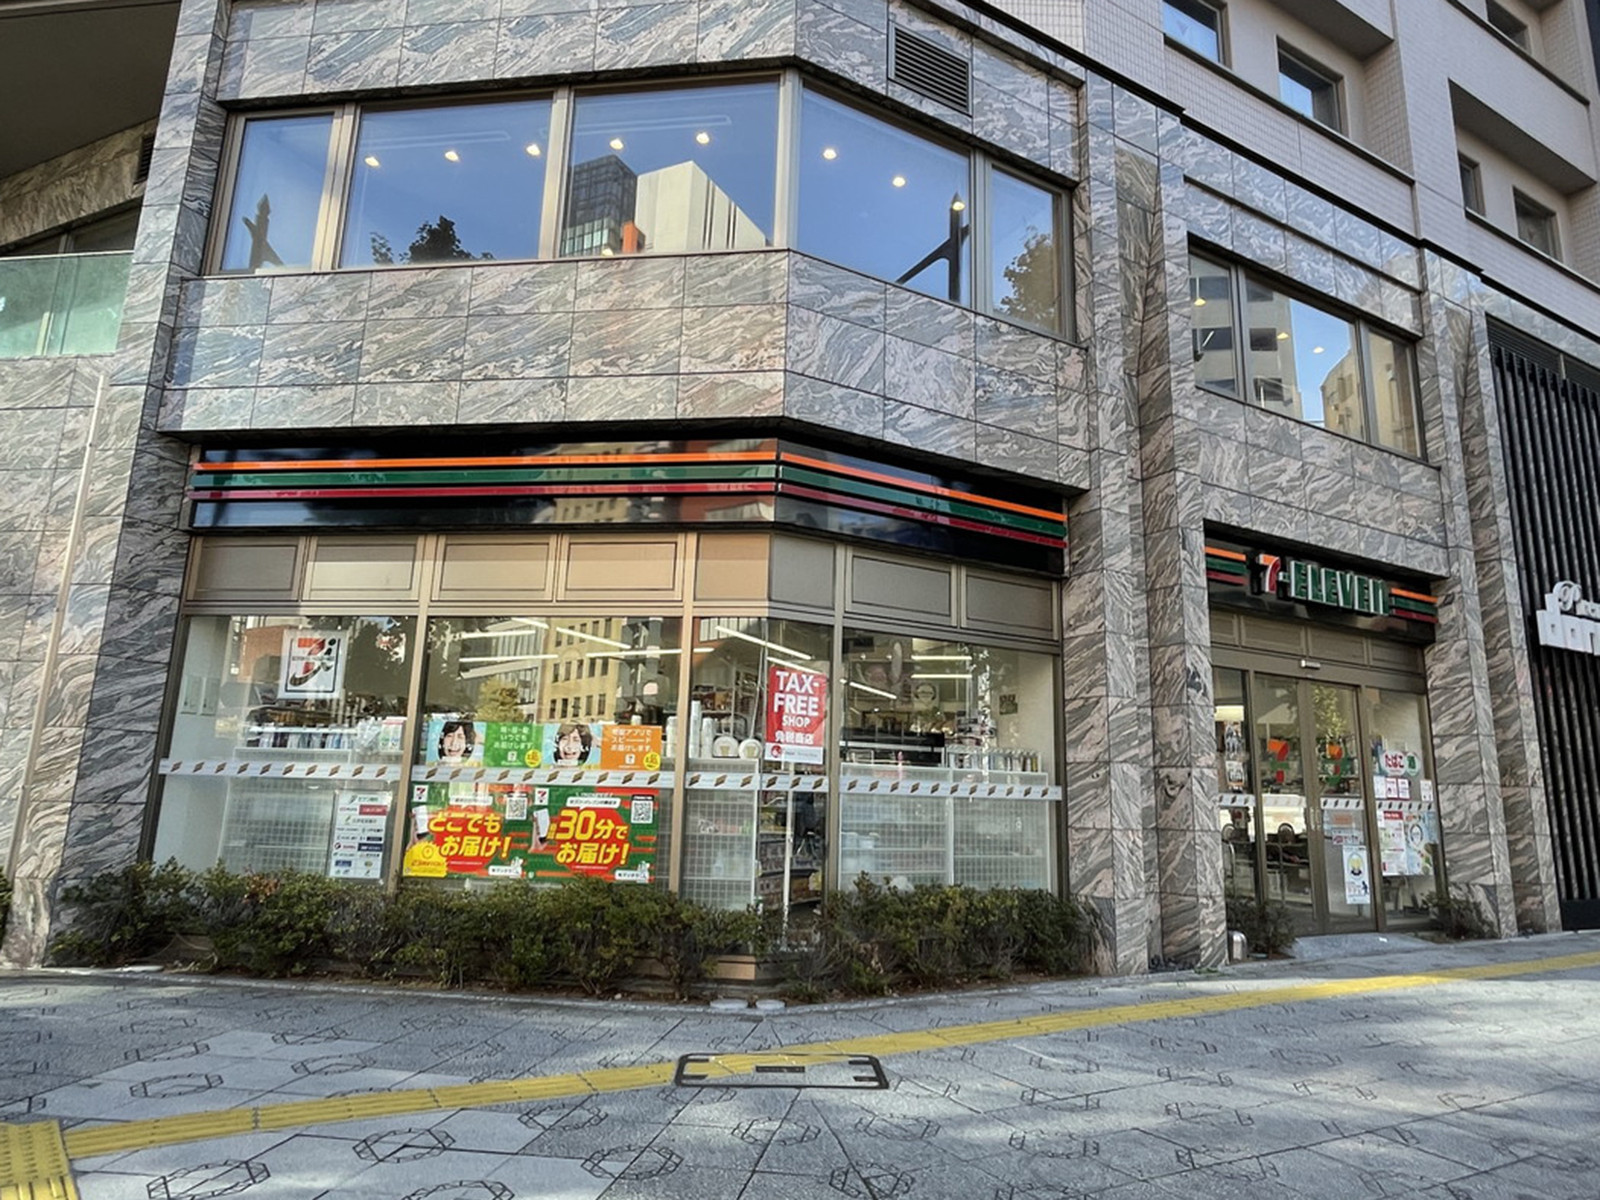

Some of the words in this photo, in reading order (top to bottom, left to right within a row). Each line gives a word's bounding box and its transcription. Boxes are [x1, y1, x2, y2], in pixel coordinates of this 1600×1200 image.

[775, 670, 820, 694] TAX-
[773, 692, 819, 716] FREE
[782, 714, 811, 728] SHOP
[428, 811, 502, 834] どこでも
[440, 835, 512, 859] お届け!
[556, 842, 630, 866] お届け!
